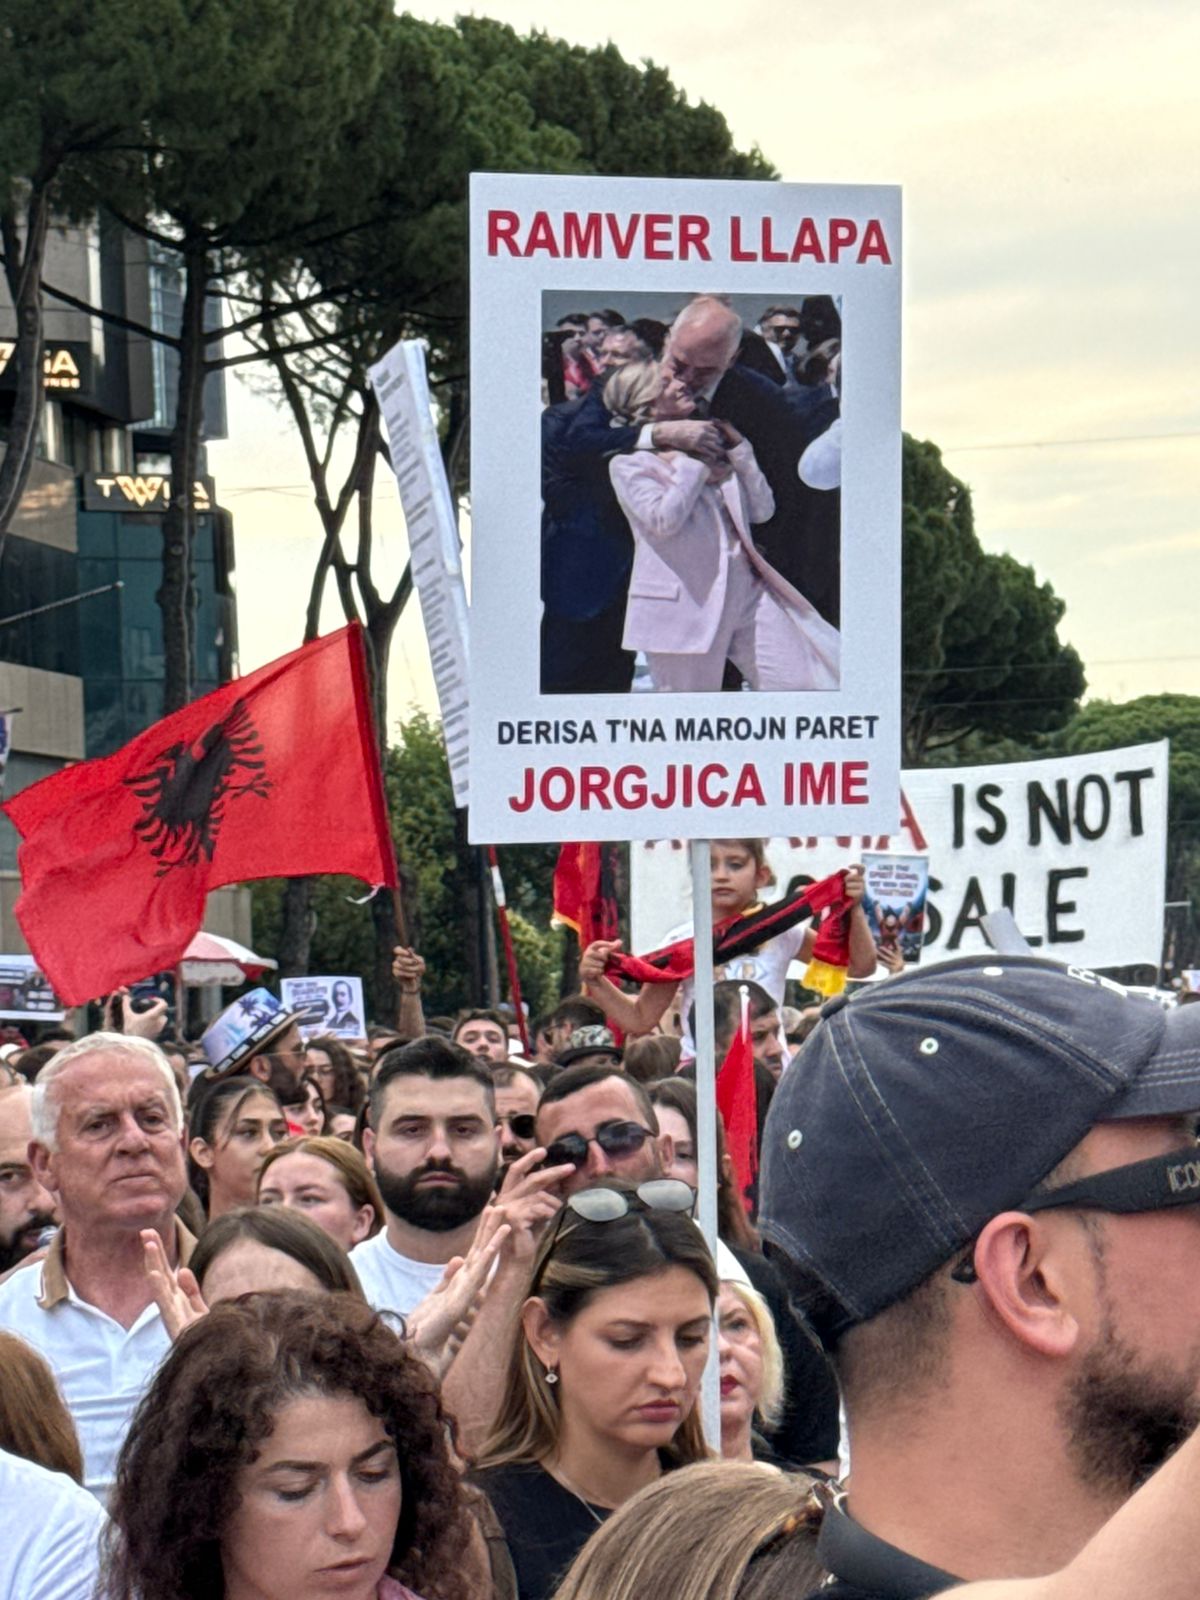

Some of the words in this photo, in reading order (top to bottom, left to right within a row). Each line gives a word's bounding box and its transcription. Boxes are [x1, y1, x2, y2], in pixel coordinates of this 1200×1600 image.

[487, 209, 712, 261] RAMVER
[730, 215, 892, 265] LLAPA
[497, 719, 598, 745] DERISA
[606, 717, 667, 743] T'NA
[675, 716, 787, 742] MAROJN
[795, 714, 880, 740] PARET
[508, 762, 767, 813] JORGJICA
[784, 760, 869, 806] IME
[952, 782, 1008, 850] IS
[1026, 766, 1155, 847] NOT
